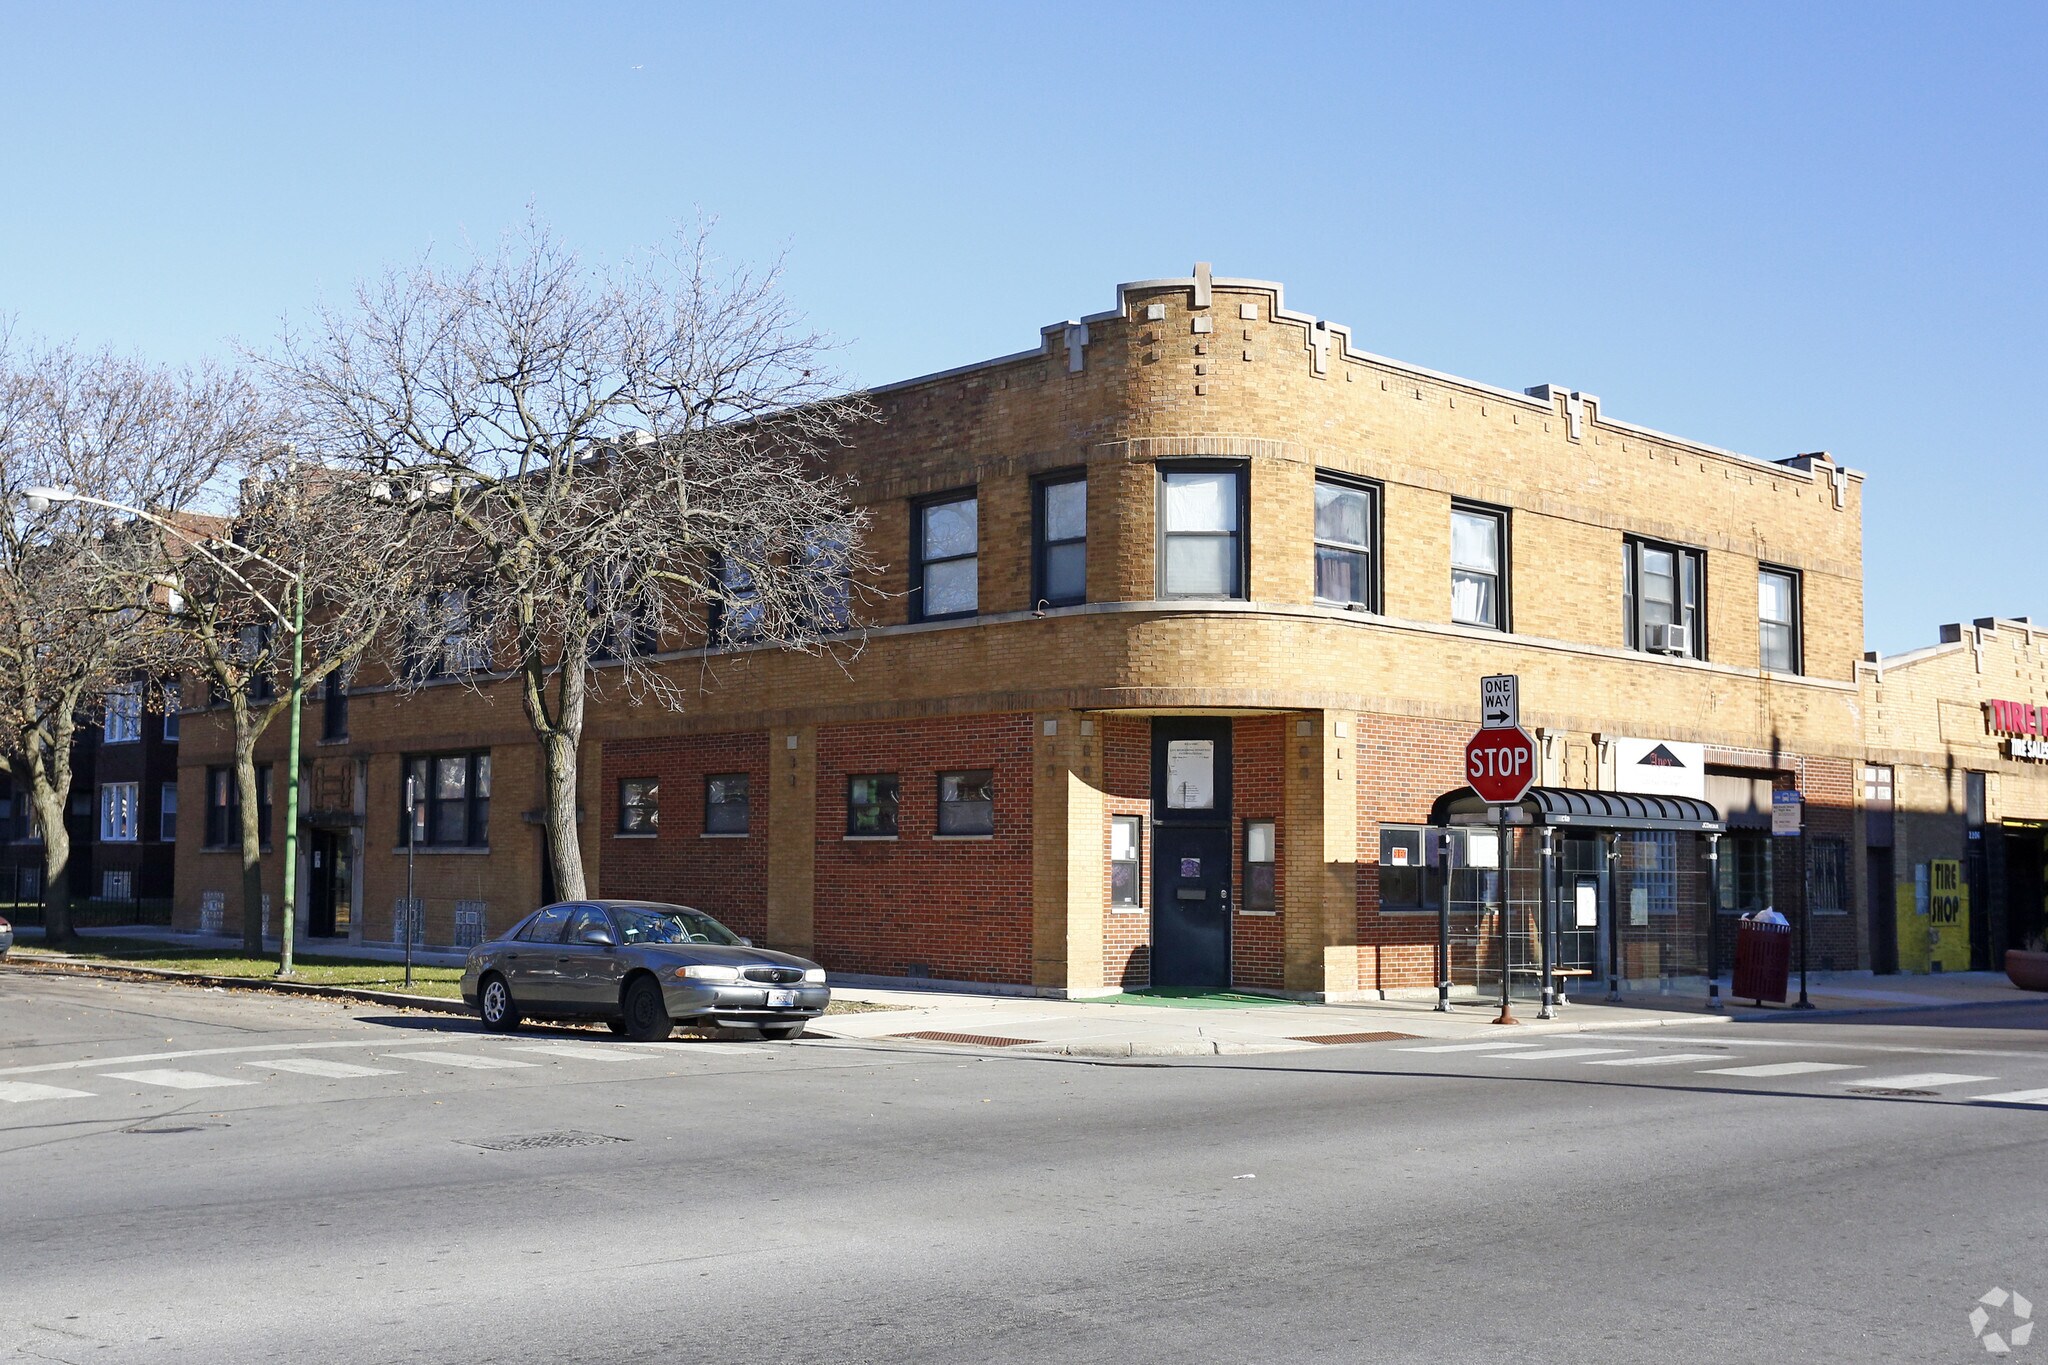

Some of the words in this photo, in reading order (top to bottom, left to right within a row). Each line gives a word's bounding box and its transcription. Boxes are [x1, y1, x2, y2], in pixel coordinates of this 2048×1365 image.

[1485, 680, 1510, 693] ONE
[1485, 694, 1511, 708] WAY
[1991, 699, 2037, 735] TIRE
[2011, 738, 2028, 757] TIRE
[1470, 747, 1529, 778] STOP
[1935, 864, 1957, 890] TIRE
[1932, 895, 1959, 923] SHOP
